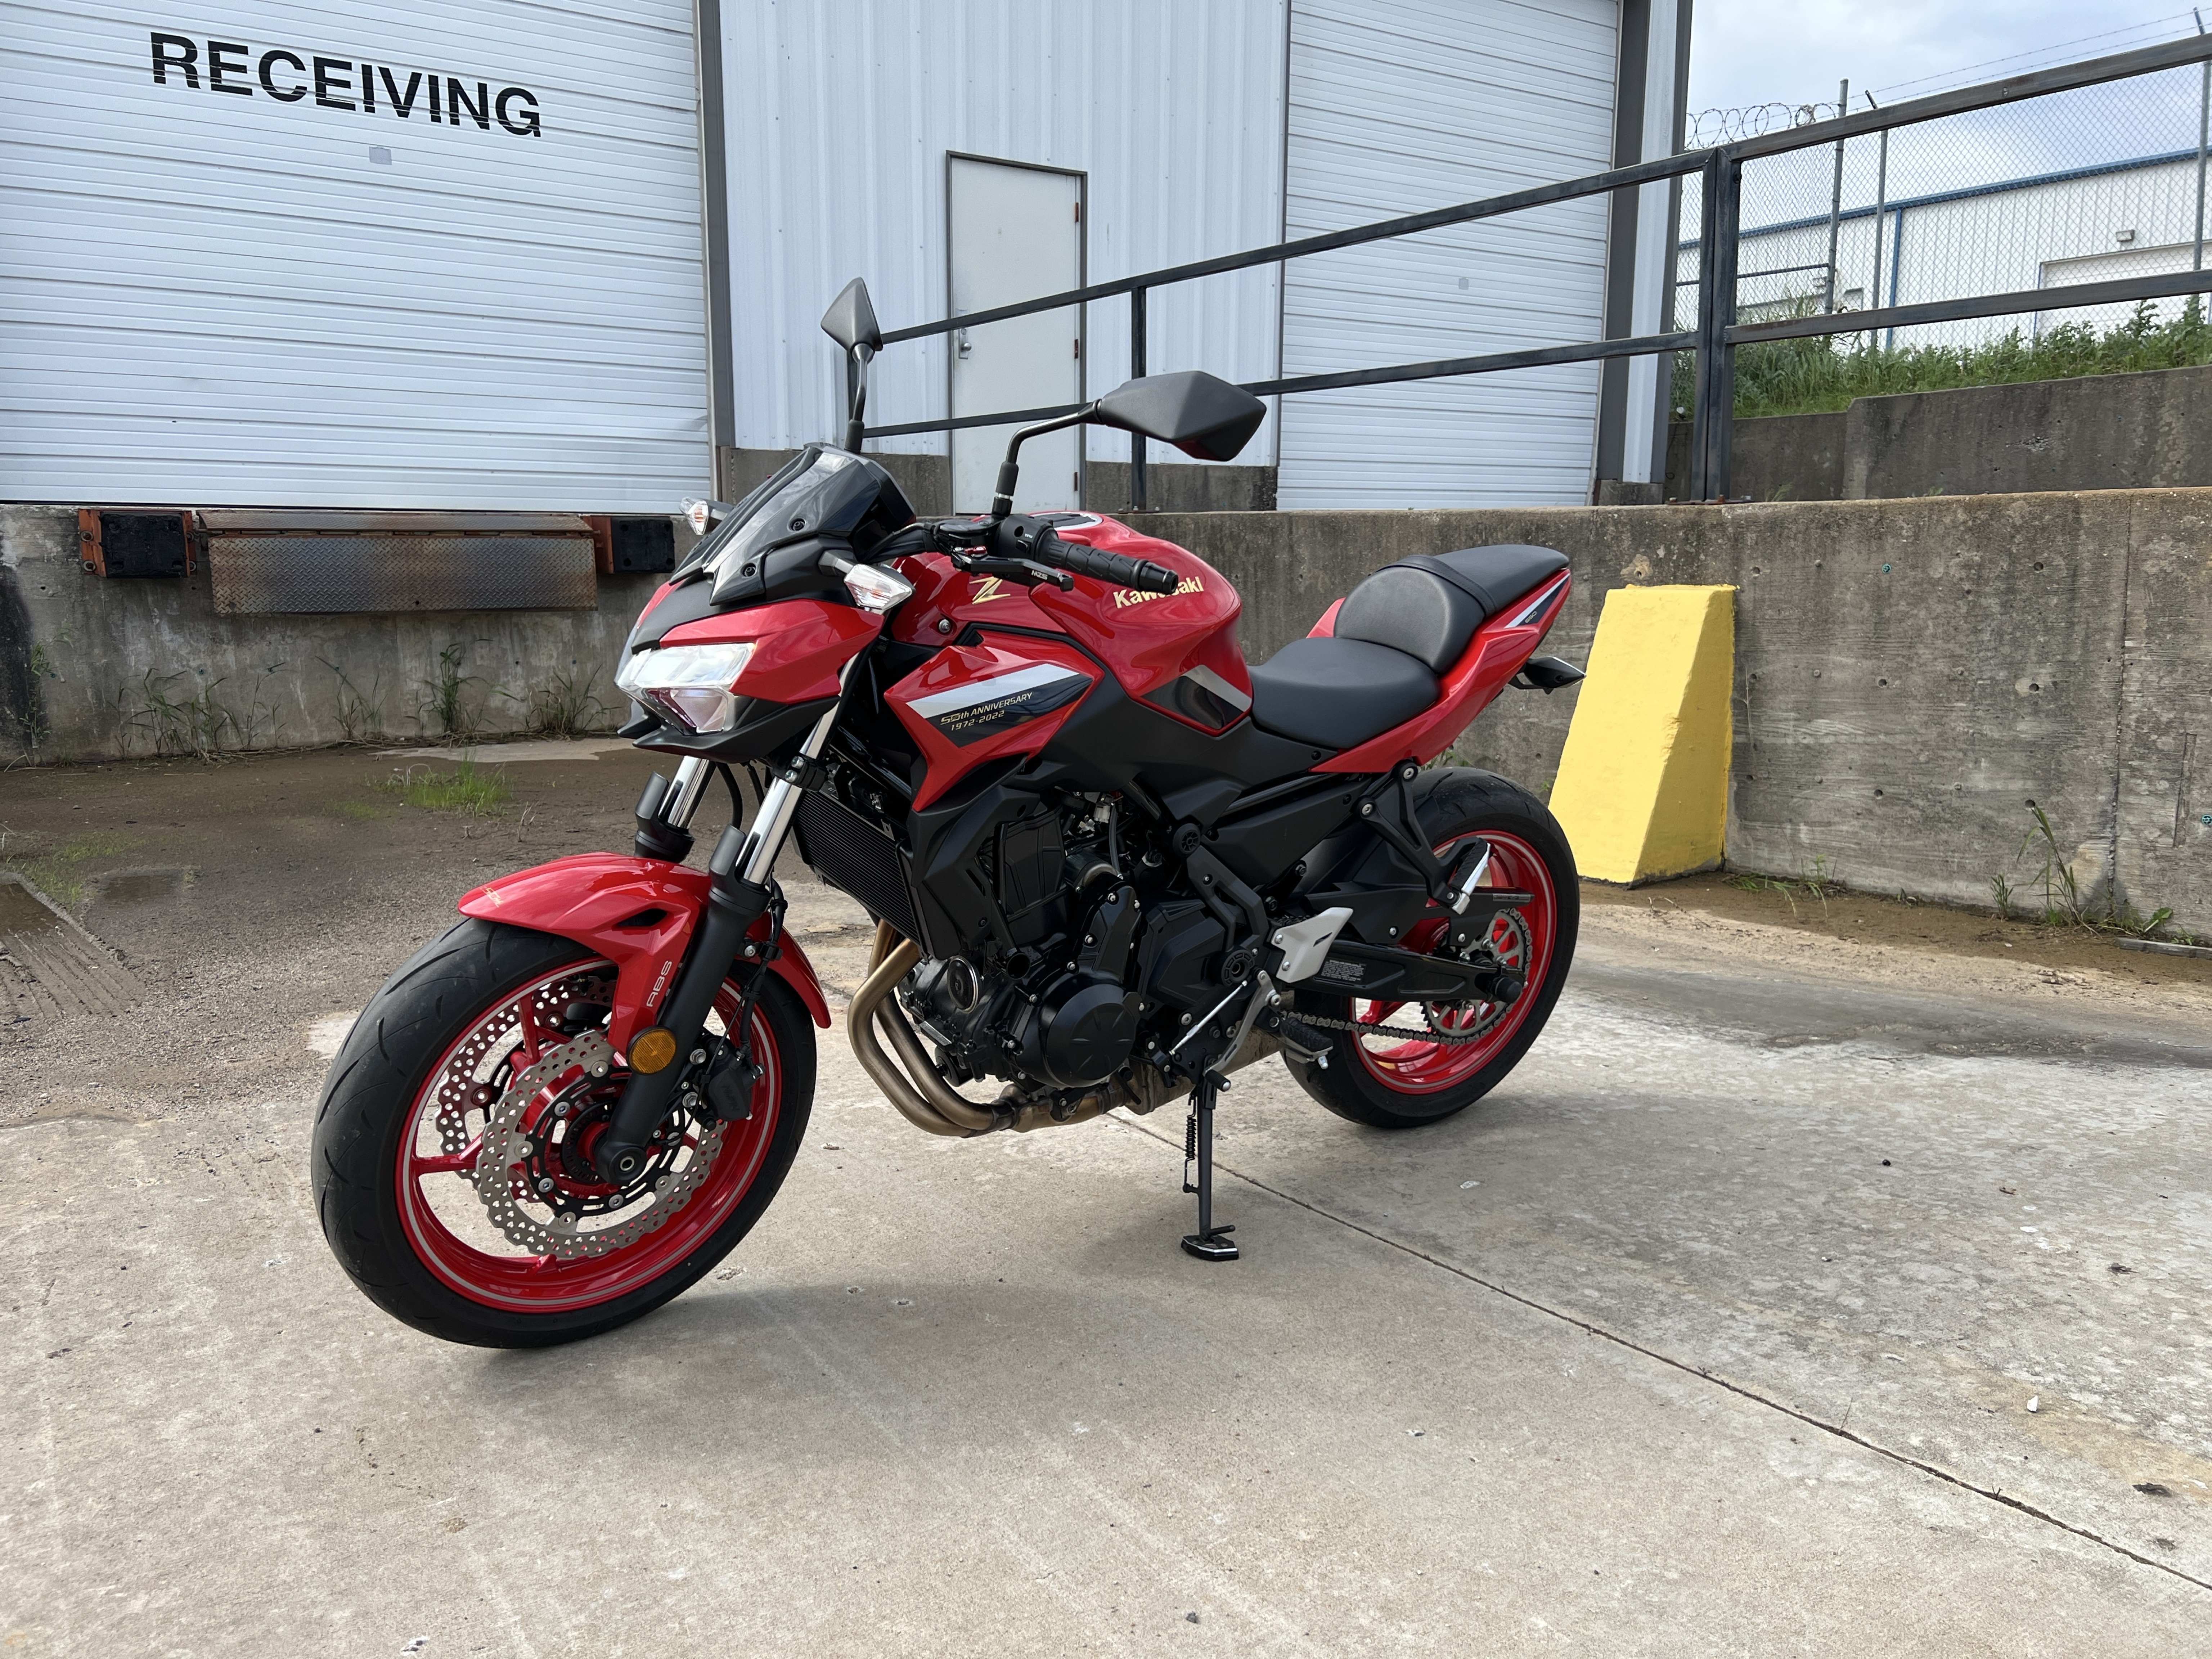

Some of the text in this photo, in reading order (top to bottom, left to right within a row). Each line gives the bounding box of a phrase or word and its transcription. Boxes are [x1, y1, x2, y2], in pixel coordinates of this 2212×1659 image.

[150, 31, 541, 138] RECEIVING
[969, 576, 1011, 605] Z
[1113, 576, 1204, 609] Kawaki
[940, 692, 1033, 725] 50th ANNIVERSARY
[951, 710, 1005, 731] 1972-2022
[646, 961, 672, 1007] ABS
